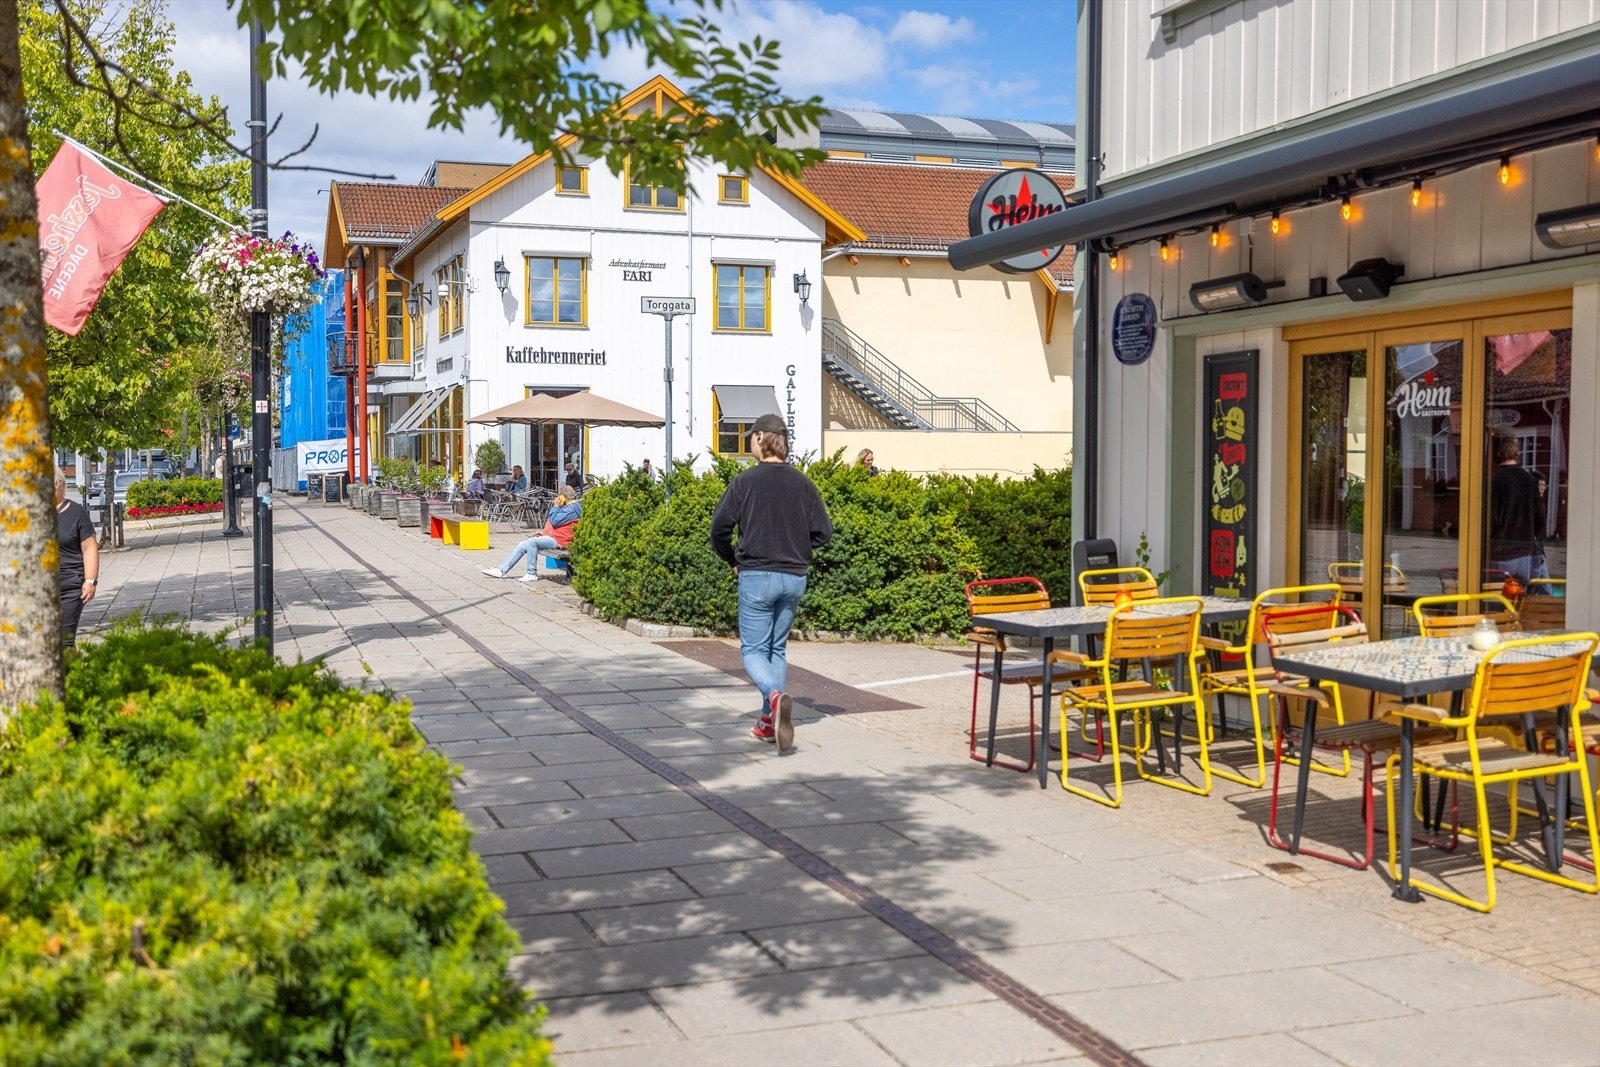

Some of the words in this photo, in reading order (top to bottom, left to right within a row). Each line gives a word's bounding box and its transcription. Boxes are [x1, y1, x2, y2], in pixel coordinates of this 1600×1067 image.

[608, 258, 667, 270] Advokatfirmaet
[623, 270, 652, 282] FARI
[646, 299, 691, 312] Torggata
[506, 345, 607, 366] Kaffebrenneriet
[1396, 382, 1451, 418] Heim
[1421, 409, 1451, 417] GASTROPUB
